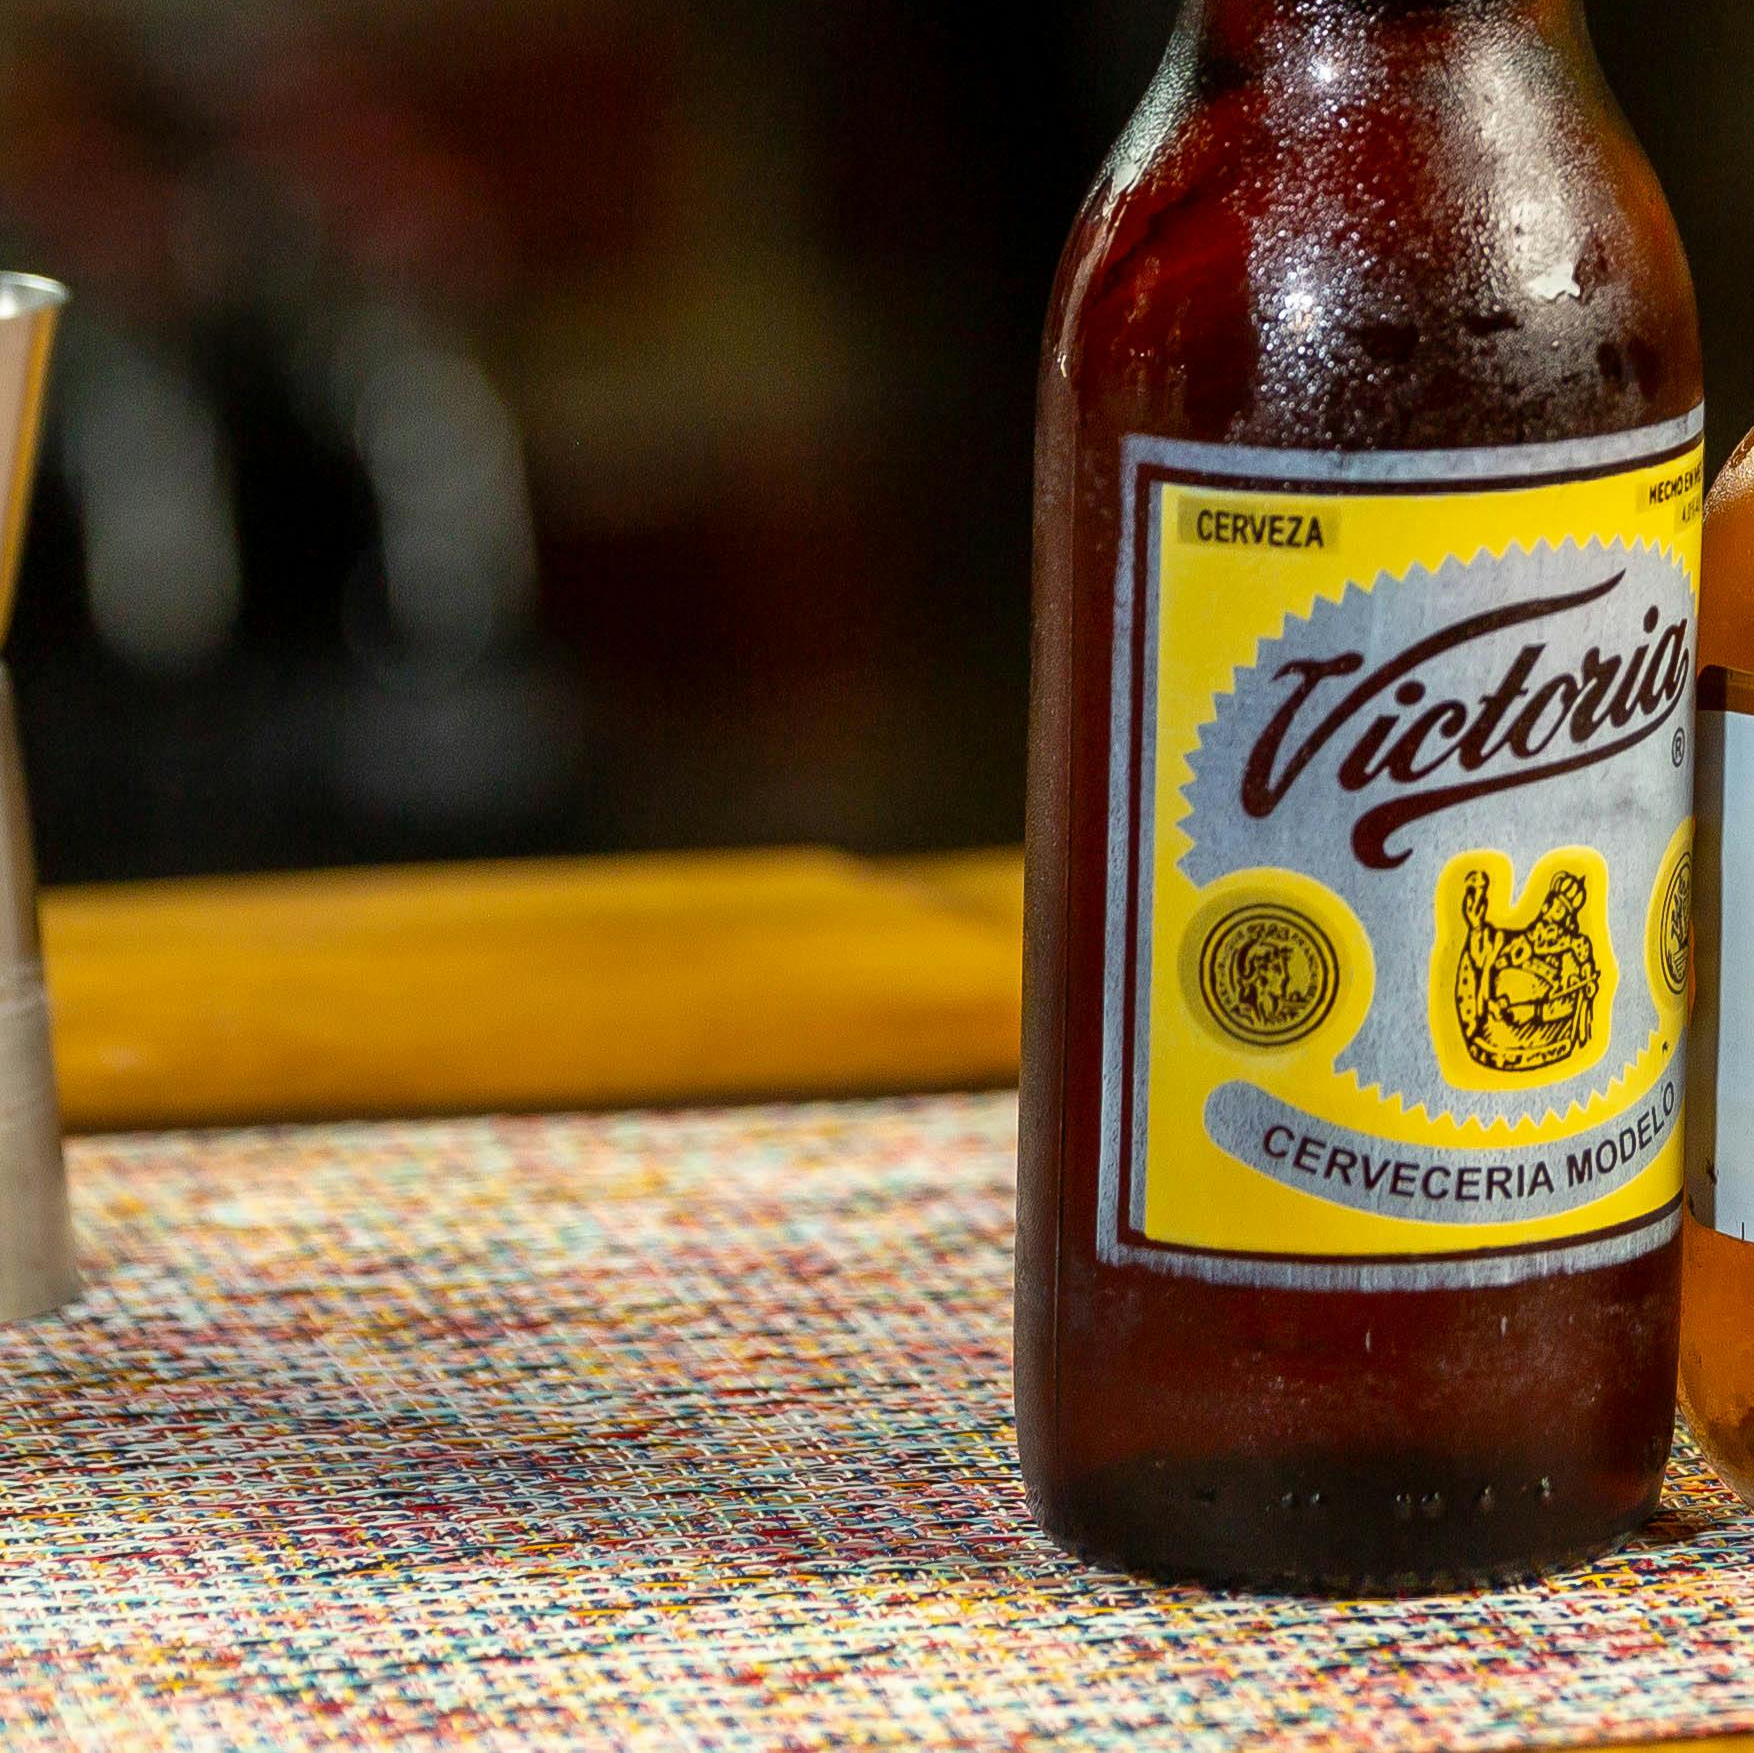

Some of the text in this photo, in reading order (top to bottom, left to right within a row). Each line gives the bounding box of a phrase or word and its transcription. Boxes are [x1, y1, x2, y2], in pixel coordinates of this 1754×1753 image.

[1196, 509, 1324, 548] CERVEZA
[1240, 567, 1690, 868] Victoria
[1261, 1079, 1676, 1202] CERVECERIA MODELO
